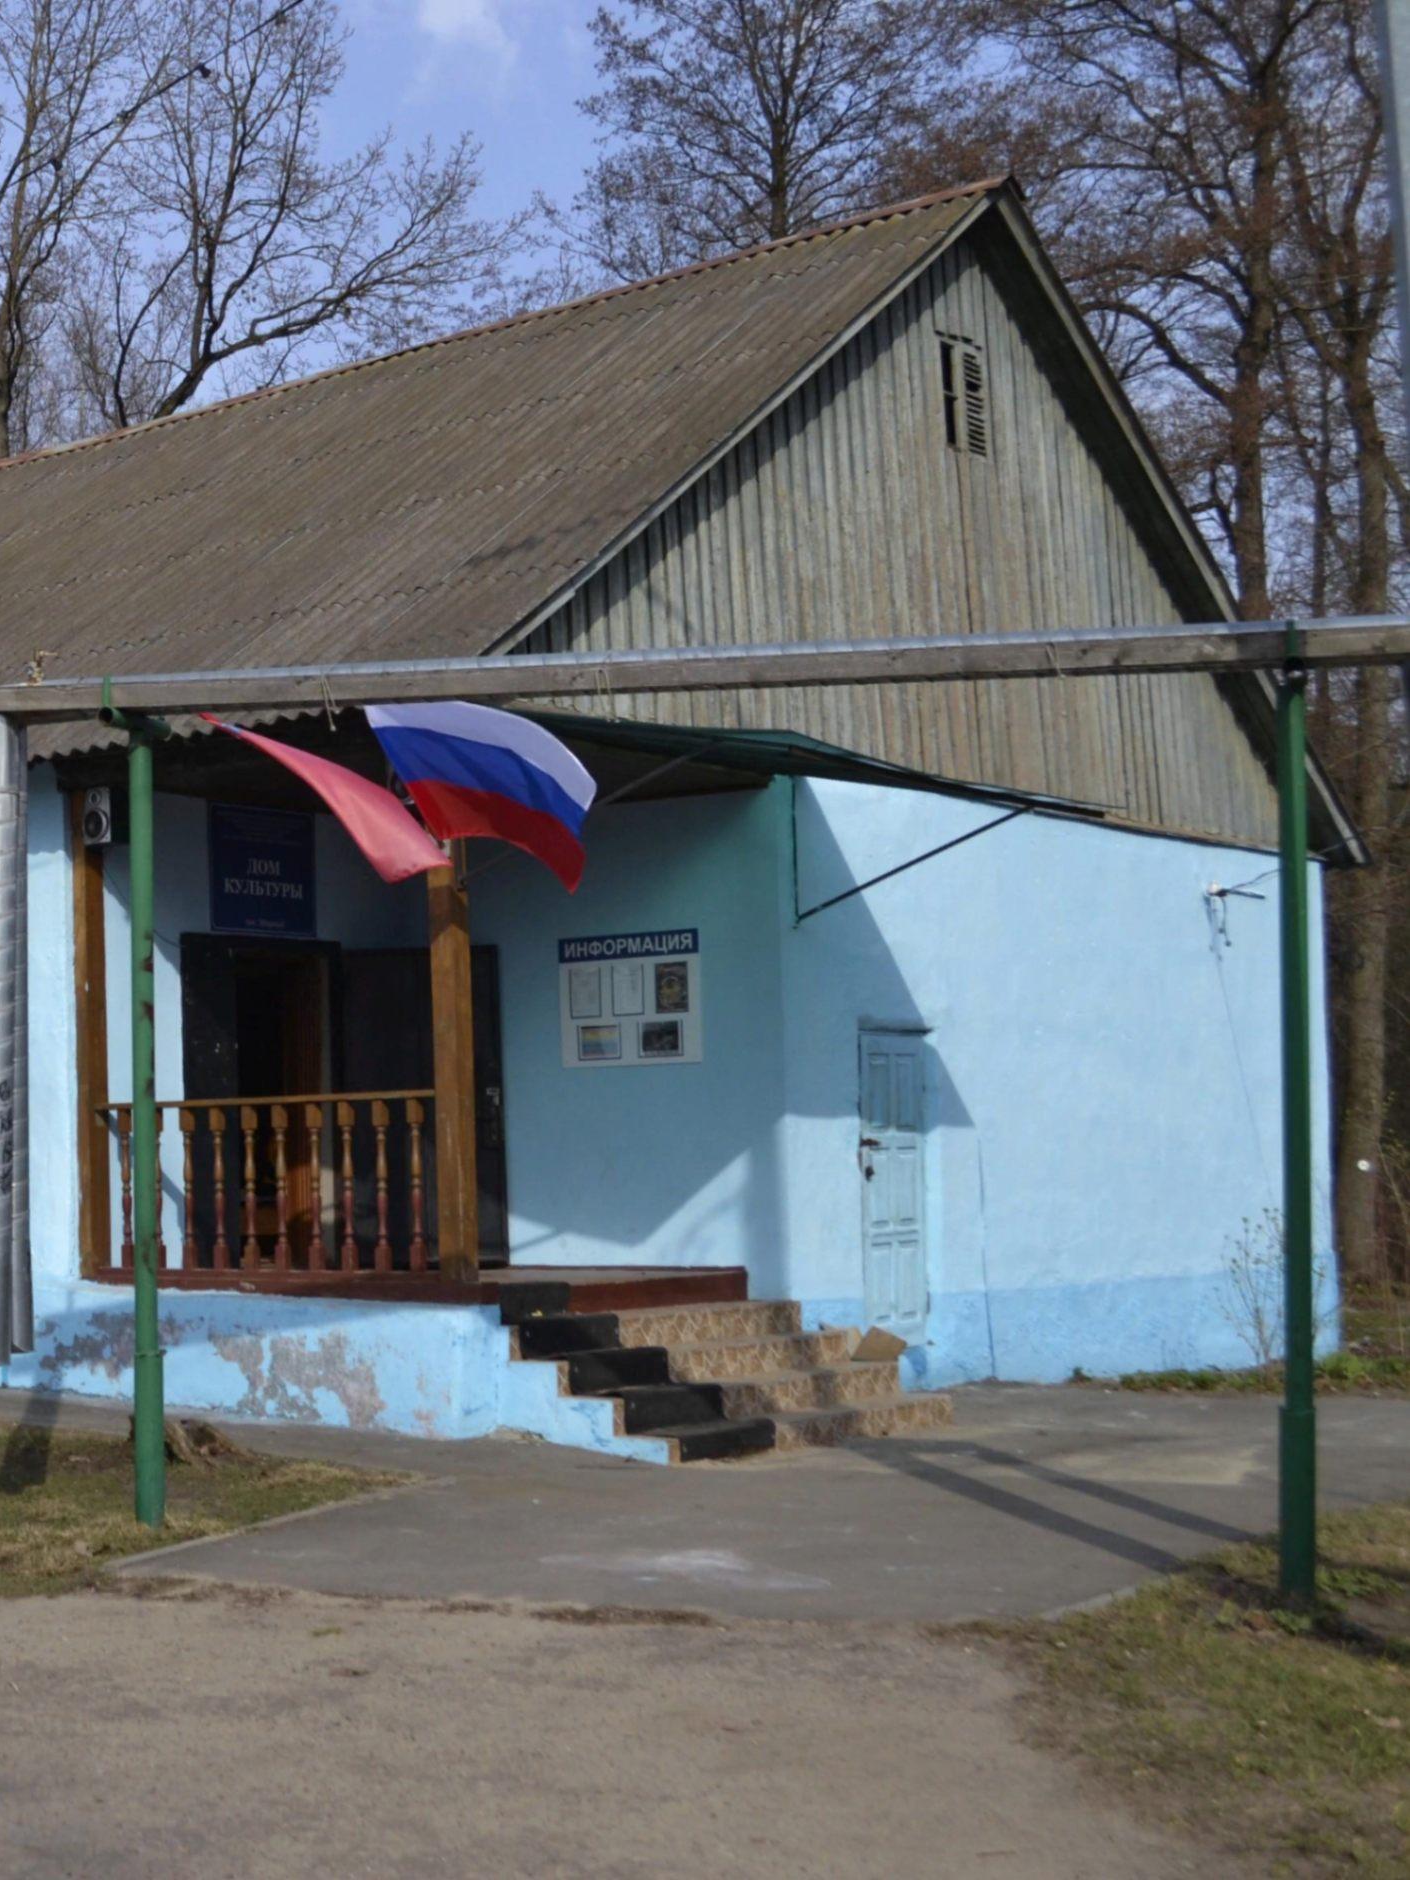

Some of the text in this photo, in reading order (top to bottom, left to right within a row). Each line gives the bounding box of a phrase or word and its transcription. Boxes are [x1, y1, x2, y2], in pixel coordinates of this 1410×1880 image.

[247, 858, 280, 876] ДОМ
[223, 878, 303, 899] КУЛЬТУРЫ
[564, 933, 693, 959] ИНФОРМАЦИЯ
